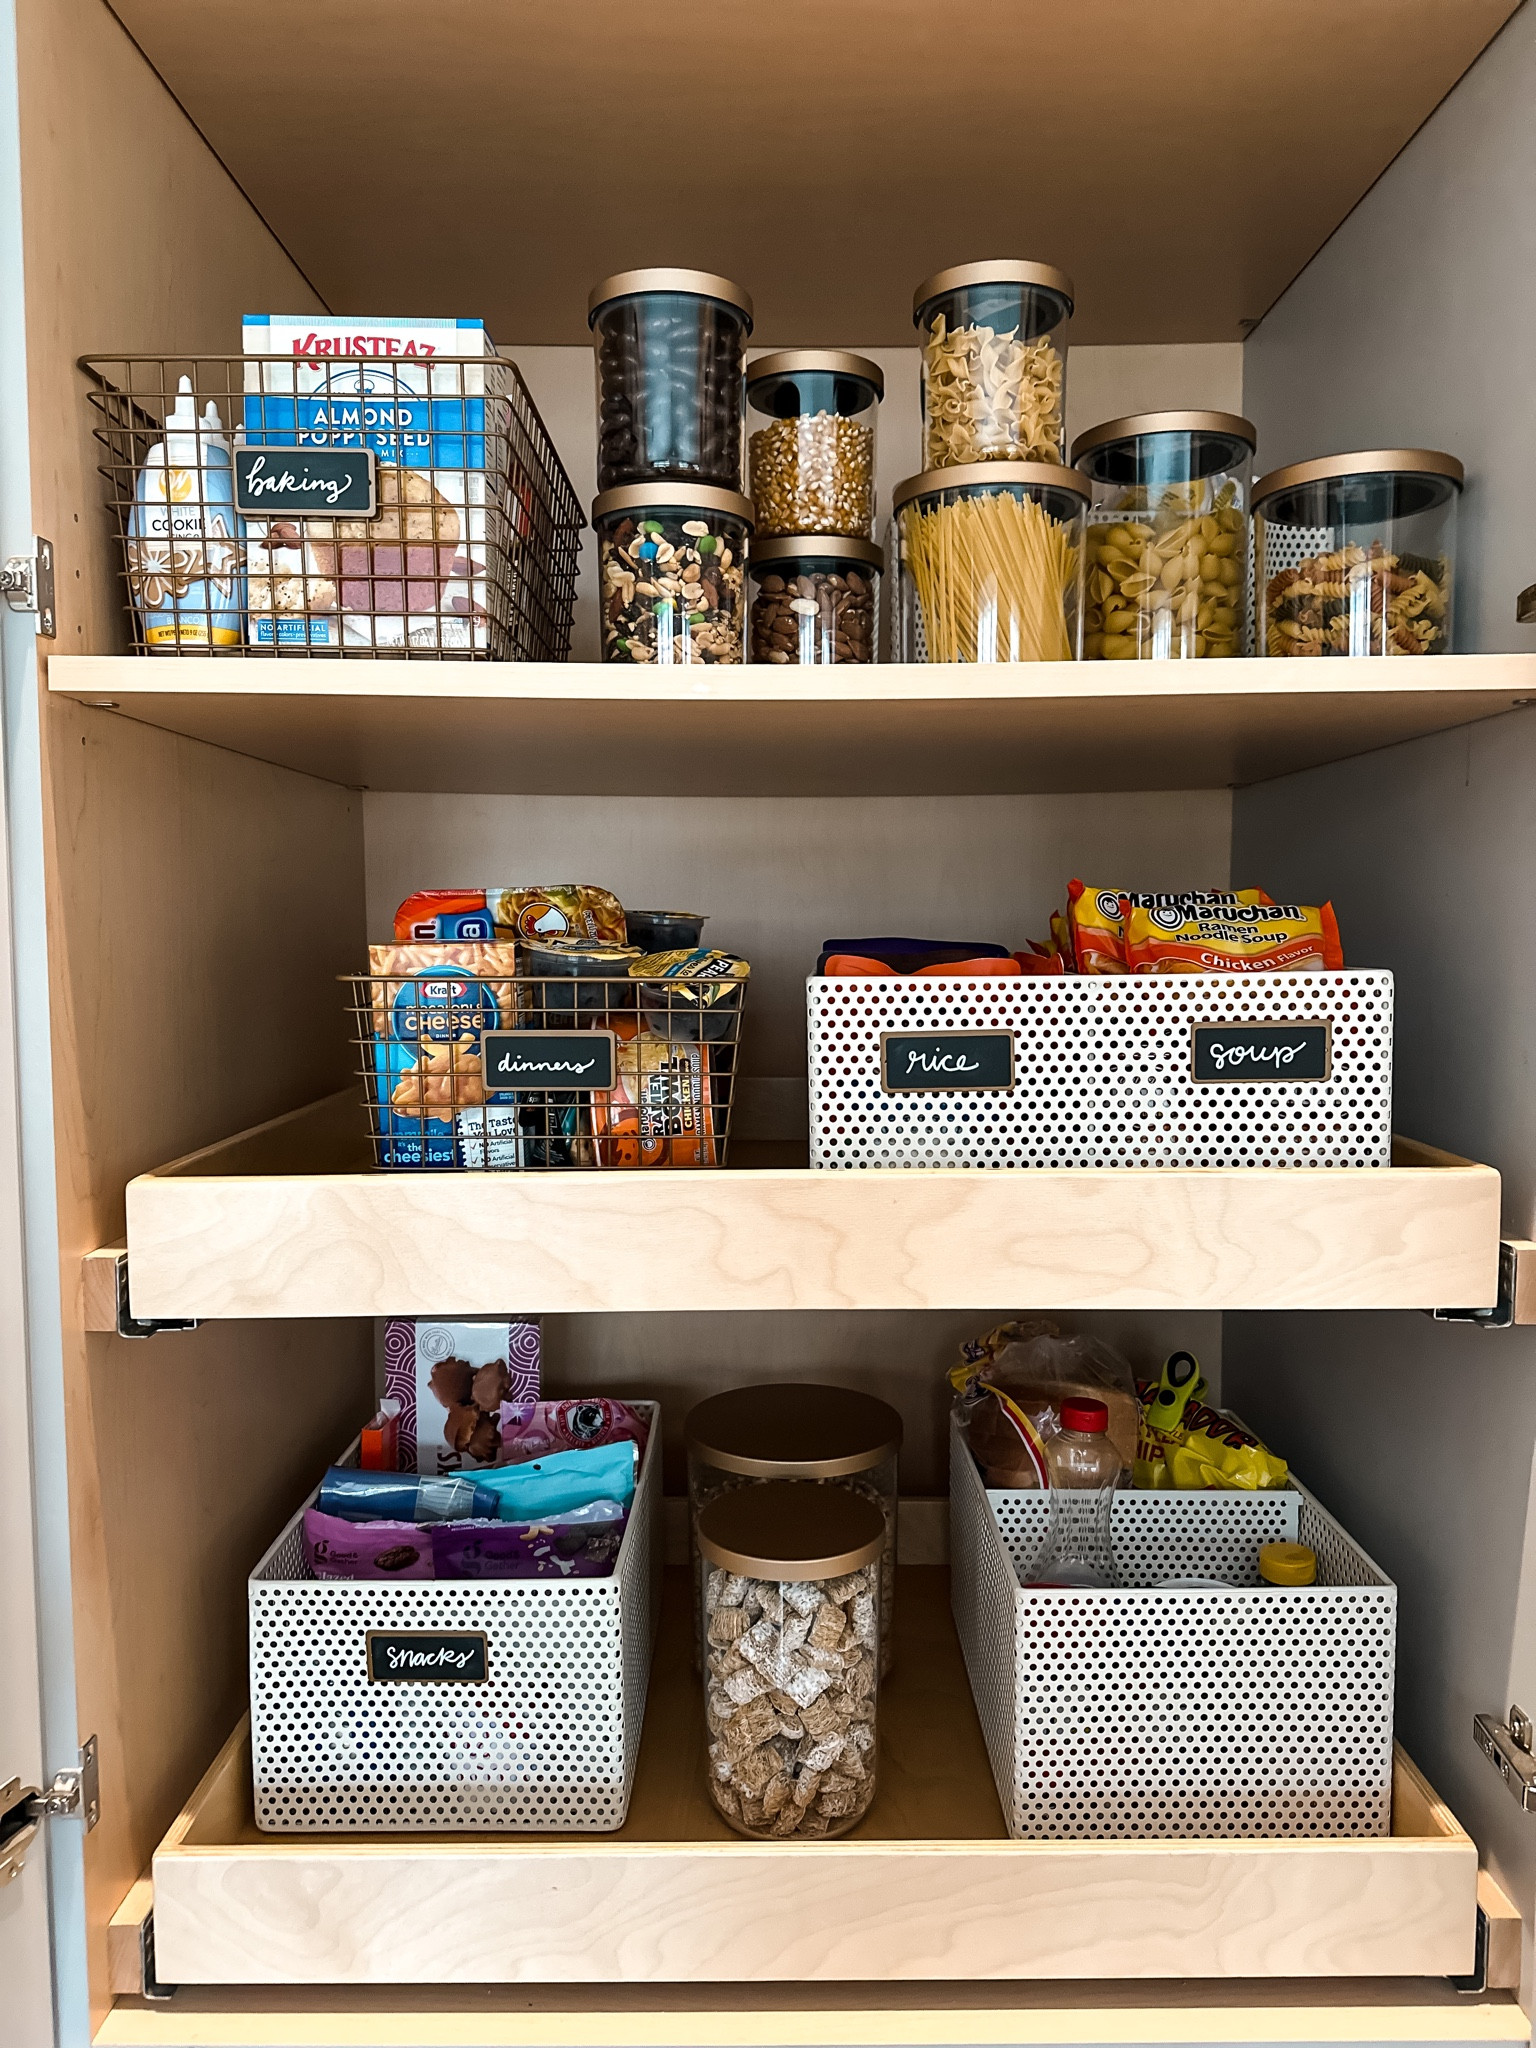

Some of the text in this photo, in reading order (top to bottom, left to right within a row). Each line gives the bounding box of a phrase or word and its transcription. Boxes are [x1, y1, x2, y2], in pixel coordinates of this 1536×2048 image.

[292, 332, 437, 371] KRUSTEAZ
[313, 407, 413, 426] ALMOND
[375, 429, 431, 447] SEED
[245, 455, 353, 504] baking
[151, 518, 206, 532] COOKIE
[276, 624, 326, 632] ARTIFIIAL
[1118, 891, 1239, 909] Maruchan
[1177, 904, 1303, 922] Maruchan
[1175, 930, 1288, 944] Noodle Soup
[1198, 922, 1259, 935] Ramen
[1200, 945, 1314, 971] Chicken Flavor
[497, 1052, 596, 1074] dinners
[905, 1046, 979, 1074] rice
[1209, 1040, 1307, 1069] soup
[660, 1056, 682, 1136] BOWL
[683, 1079, 692, 1128] CHICKEN
[386, 1646, 475, 1669] snacks
